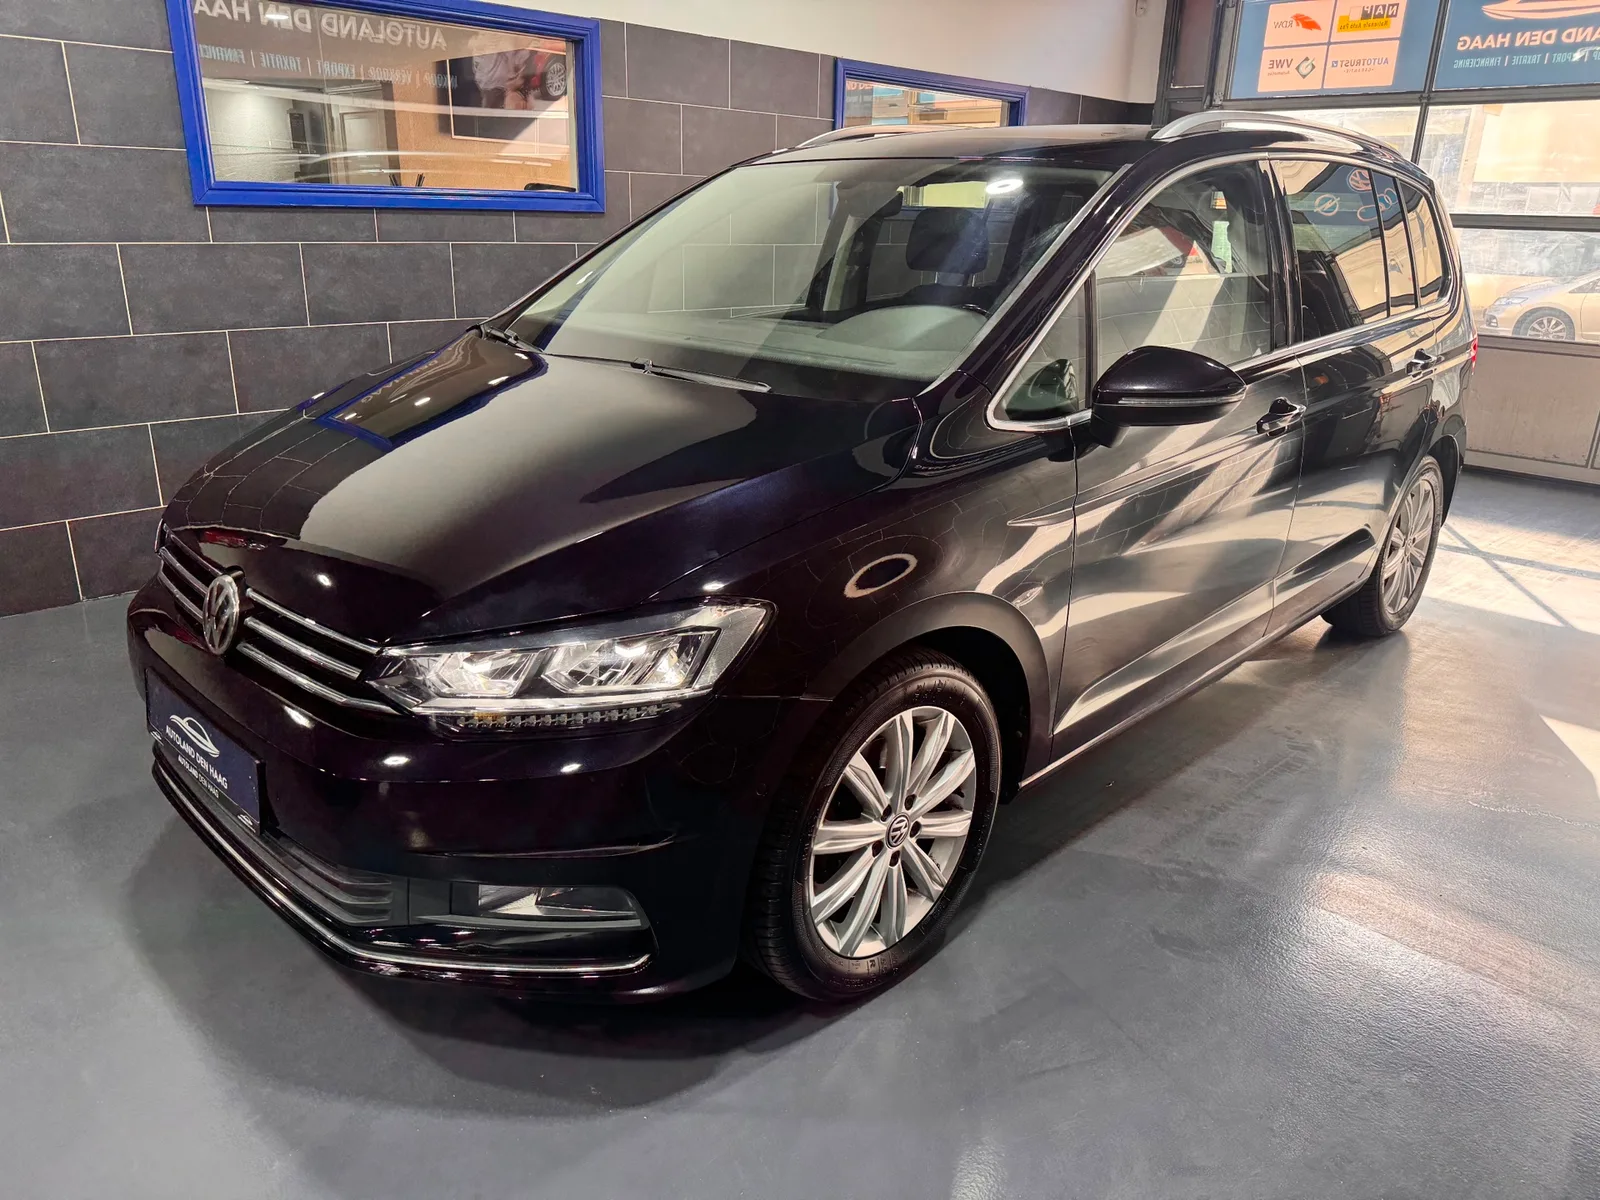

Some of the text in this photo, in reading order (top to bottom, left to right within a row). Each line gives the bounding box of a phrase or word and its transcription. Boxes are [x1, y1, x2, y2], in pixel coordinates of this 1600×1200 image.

[165, 724, 228, 790] AUTOLAND DEN HAAG
[178, 754, 219, 798] AUTOLAND DEN HAAG
